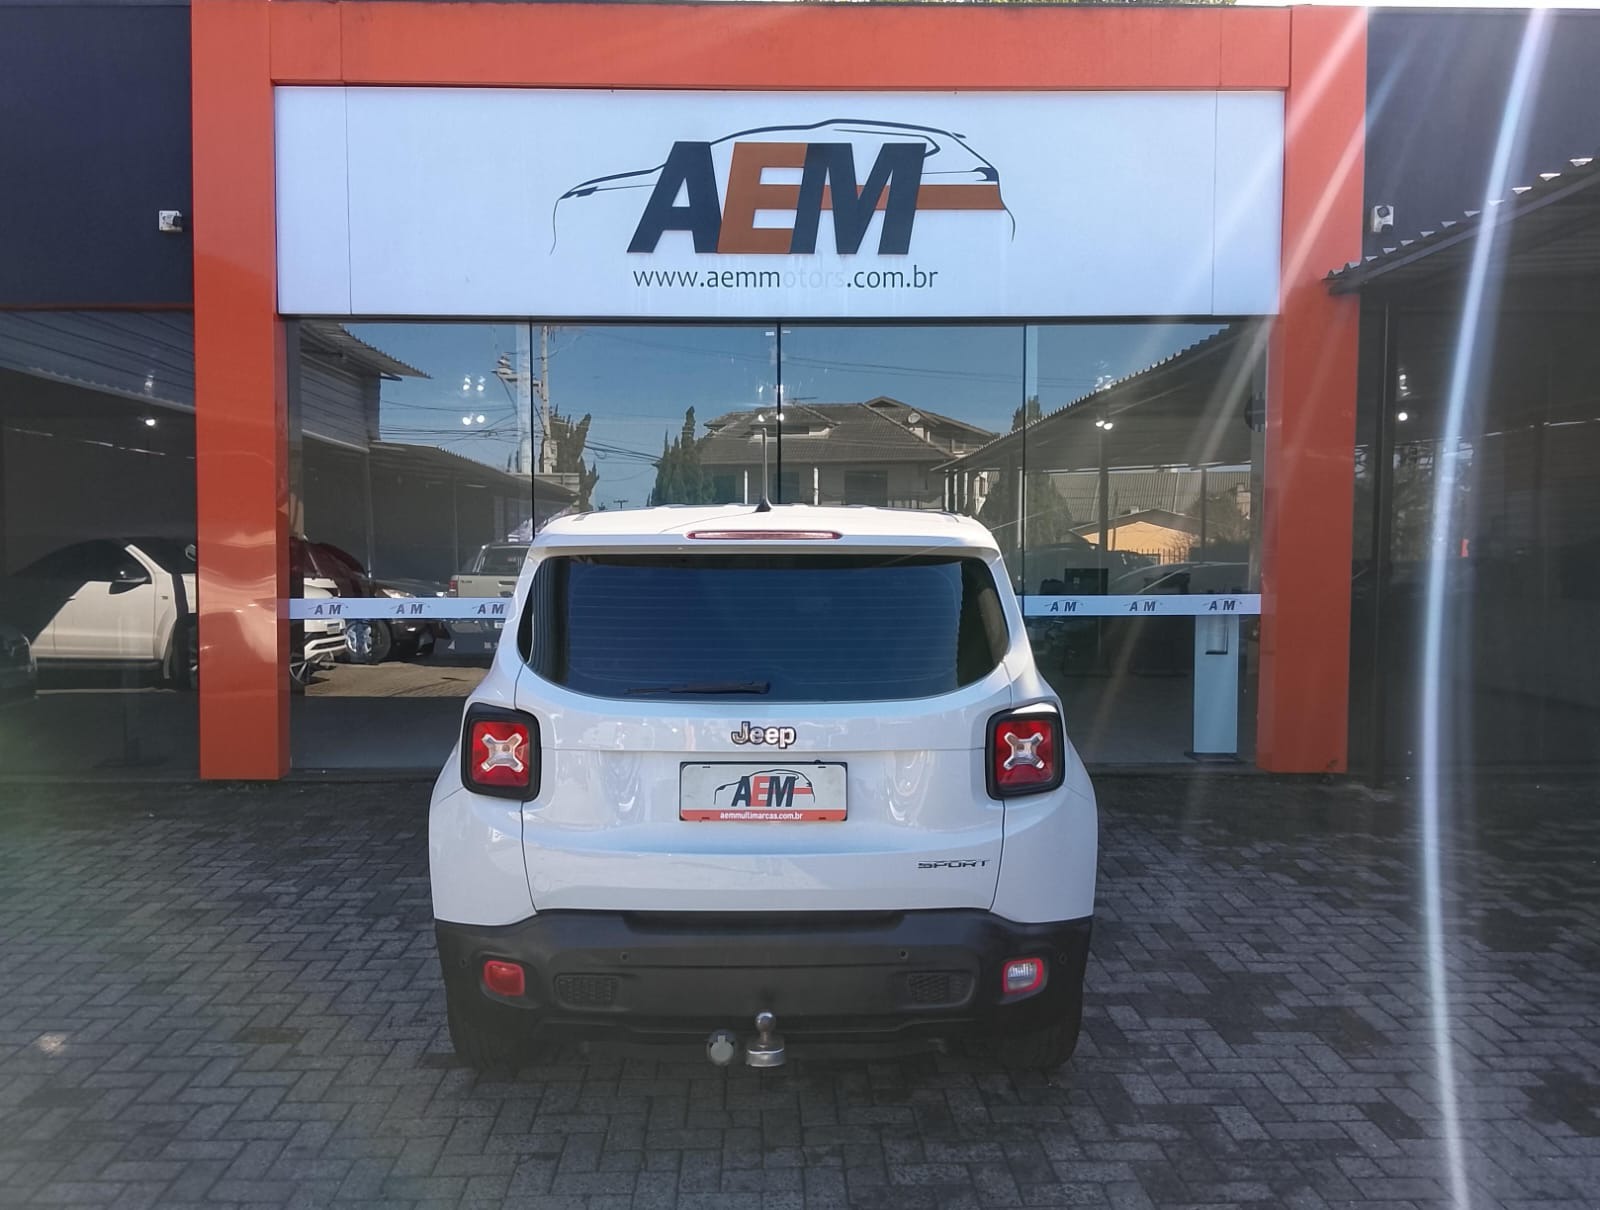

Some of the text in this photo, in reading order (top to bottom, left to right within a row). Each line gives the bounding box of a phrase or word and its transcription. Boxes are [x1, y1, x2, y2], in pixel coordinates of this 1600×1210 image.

[626, 141, 927, 254] AEM
[730, 720, 797, 749] Jeep
[731, 775, 796, 807] AEM
[720, 811, 804, 821] aemmultimarcas.com.br
[917, 859, 991, 869] SPORT
